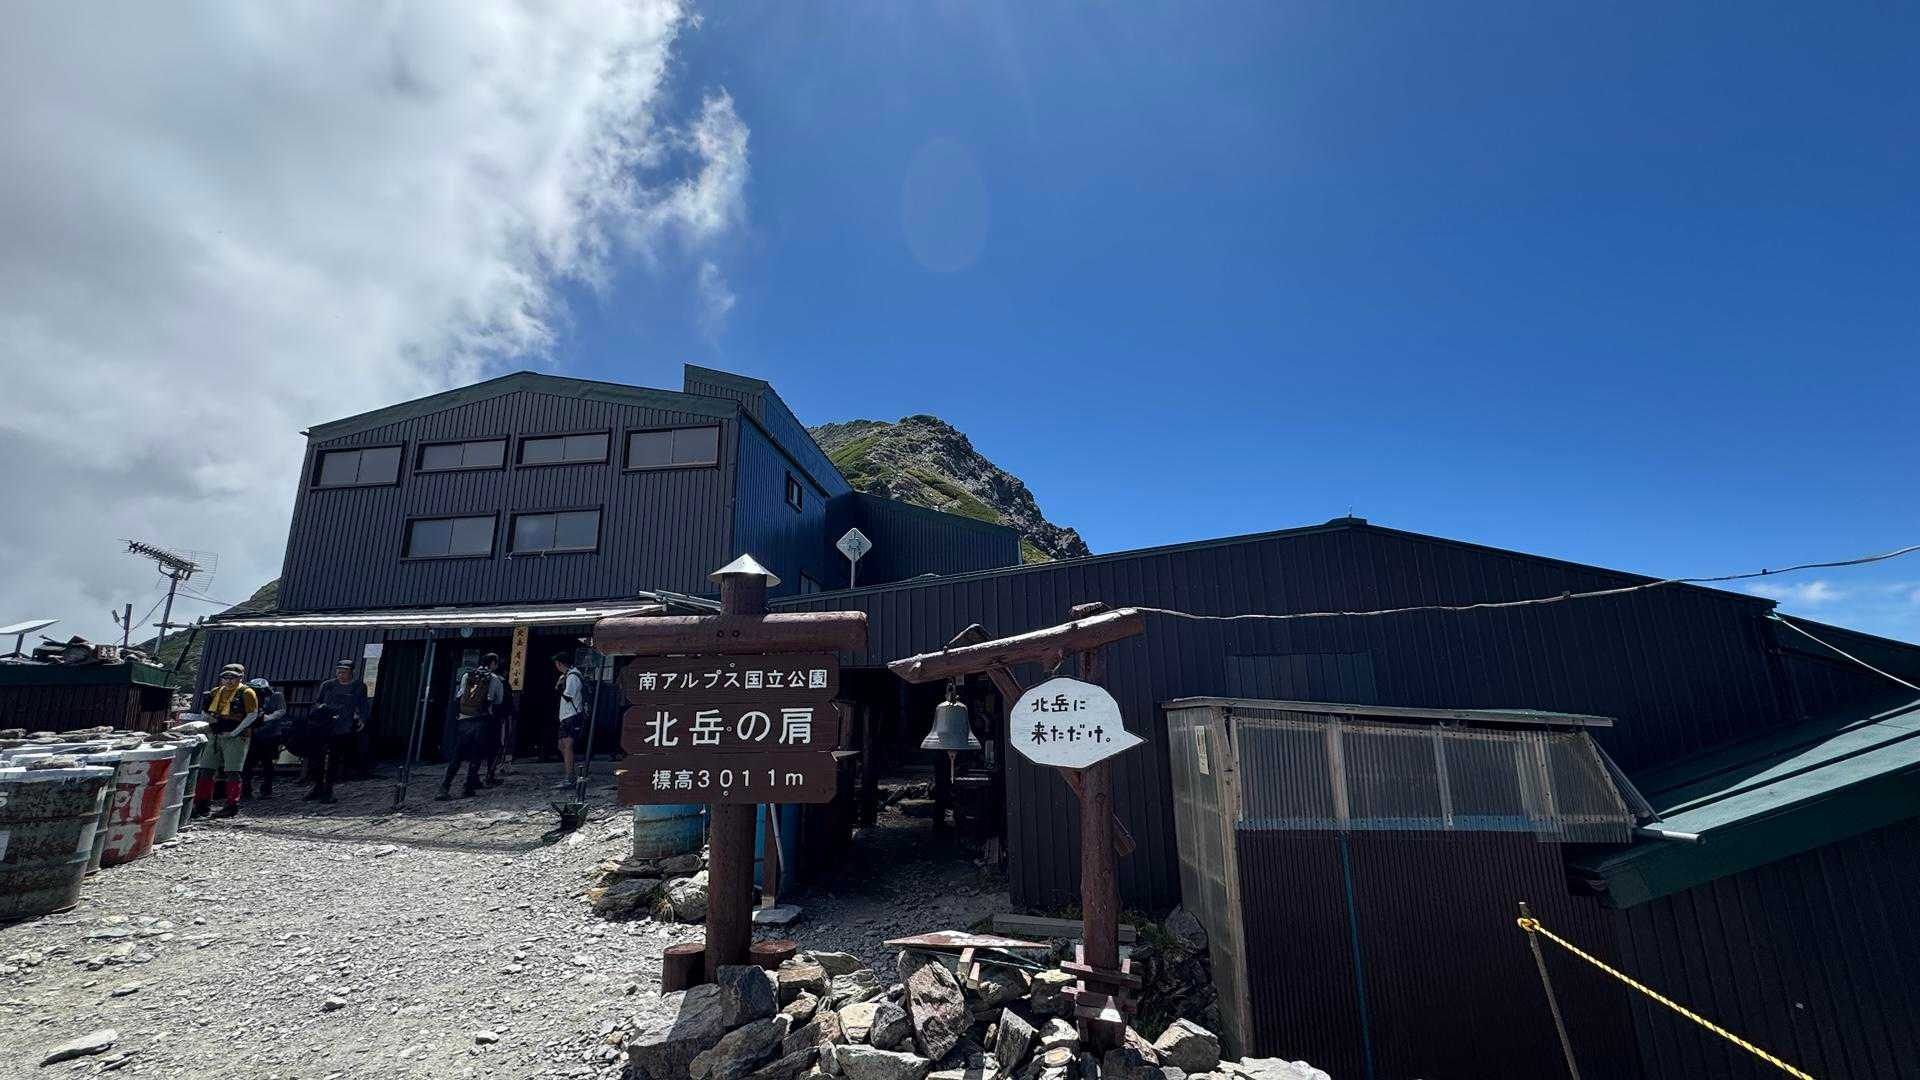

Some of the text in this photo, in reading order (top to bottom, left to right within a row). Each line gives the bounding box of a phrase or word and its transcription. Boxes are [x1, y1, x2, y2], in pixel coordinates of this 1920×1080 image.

[638, 669, 828, 691] 南アルプス国立公園
[1031, 693, 1086, 713] 北岳に
[643, 708, 814, 747] 北岳の肩
[1031, 721, 1111, 745] 来ただけ。
